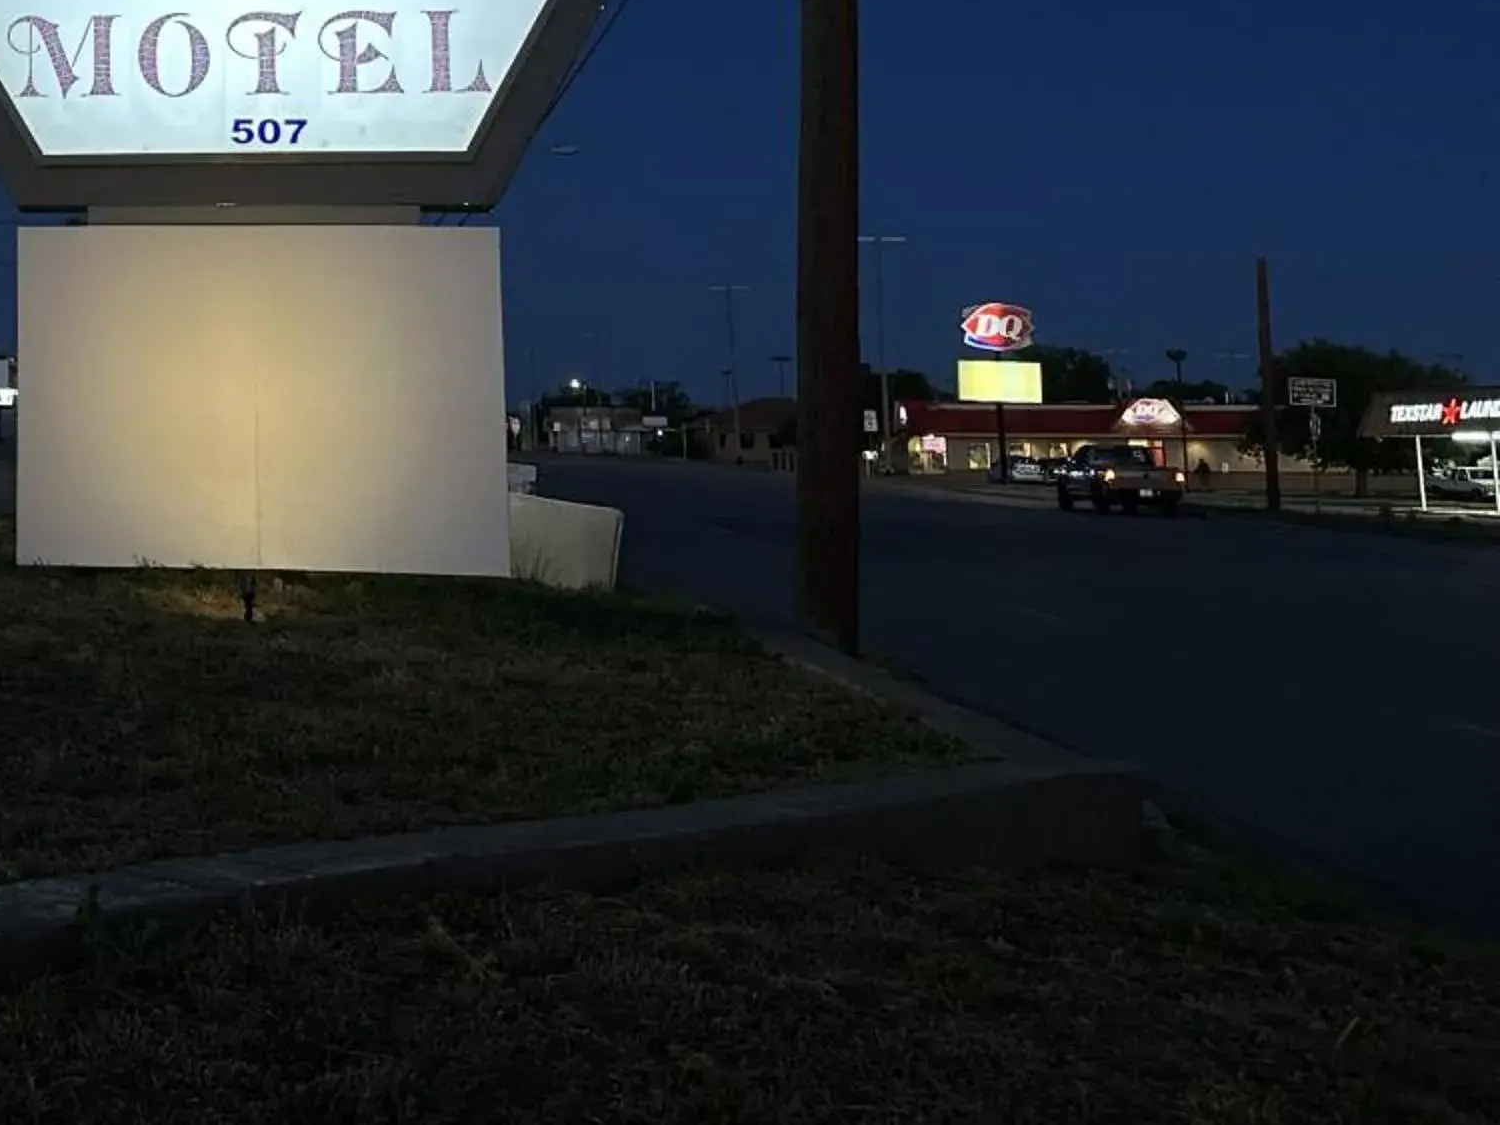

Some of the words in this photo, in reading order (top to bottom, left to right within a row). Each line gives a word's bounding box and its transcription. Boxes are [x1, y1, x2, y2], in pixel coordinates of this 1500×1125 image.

[6, 8, 493, 99] MOTEL
[230, 118, 309, 146] 507
[975, 314, 1023, 341] DQ
[1390, 403, 1443, 423] TEXSTAR
